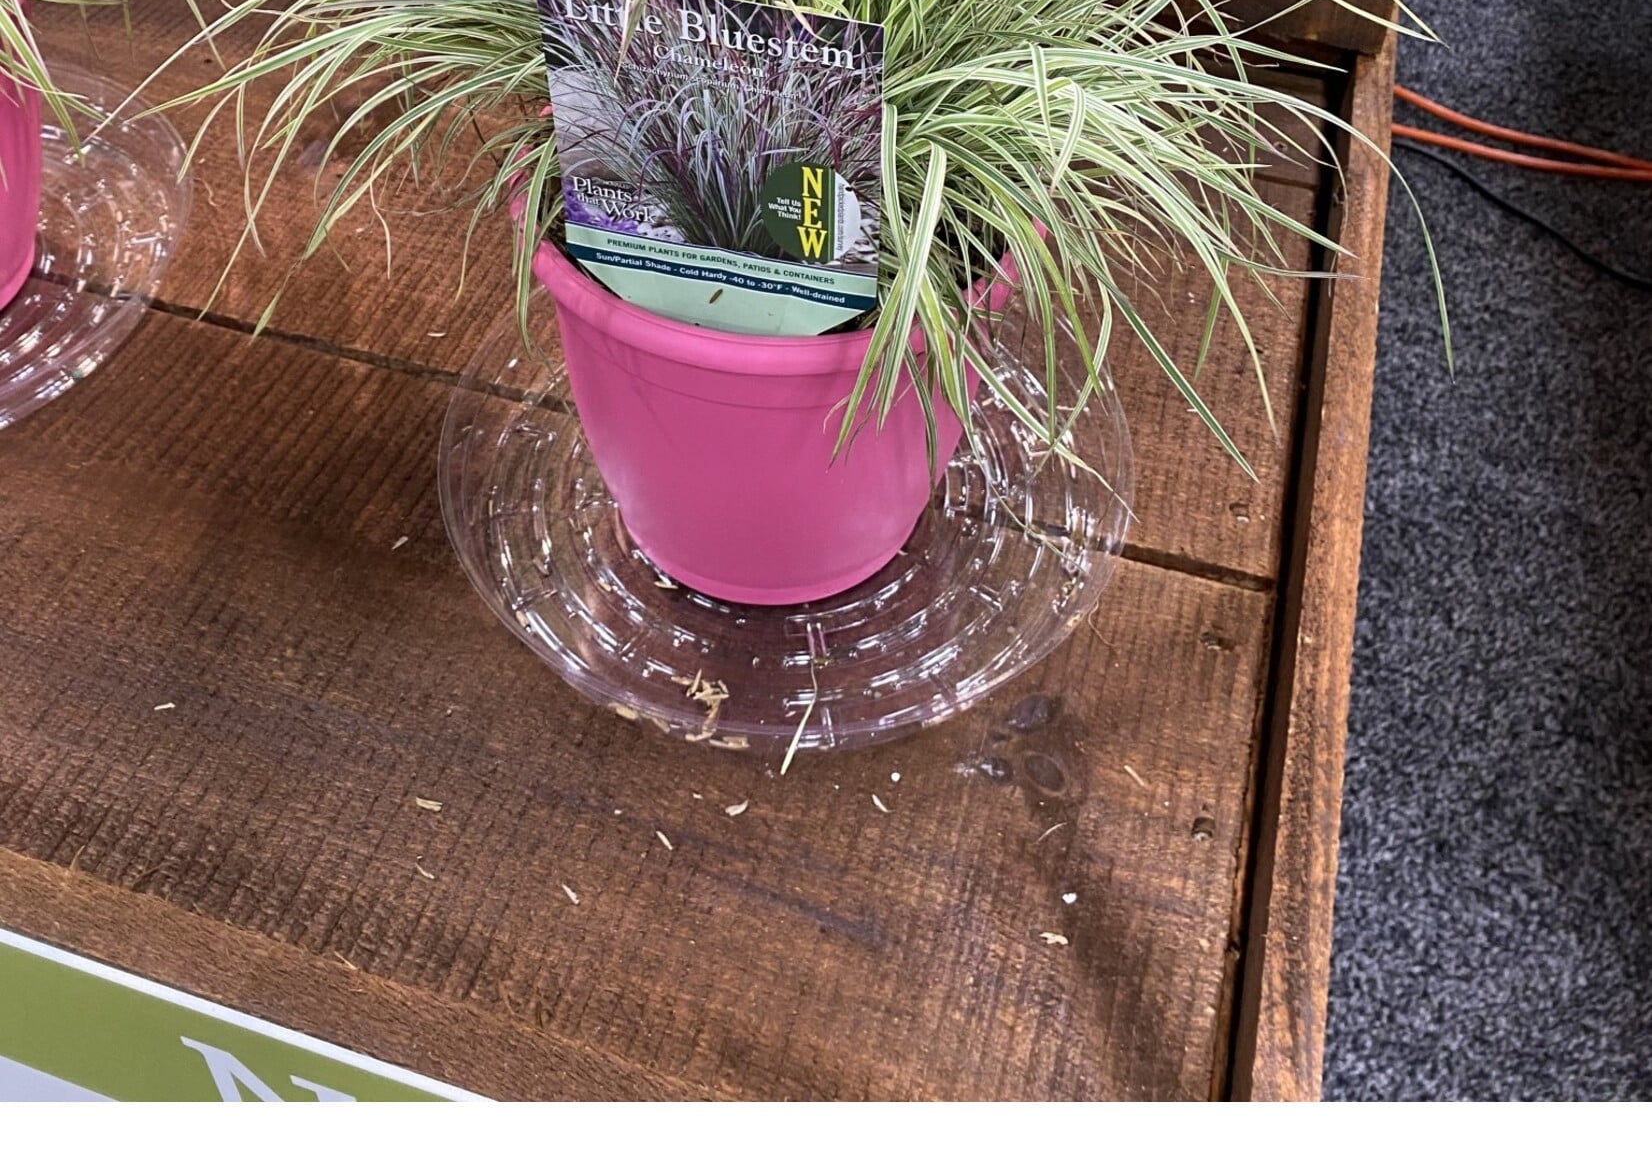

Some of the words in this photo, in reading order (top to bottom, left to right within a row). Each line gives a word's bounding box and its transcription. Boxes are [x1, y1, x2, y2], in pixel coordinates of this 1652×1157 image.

[676, 8, 855, 70] Bluestem
[570, 175, 632, 203] Plants
[577, 192, 600, 205] that
[600, 198, 657, 224] Work
[768, 202, 787, 211] What
[788, 205, 801, 214] You
[776, 196, 790, 205] Tell
[791, 199, 801, 207] Us
[796, 166, 827, 259] NEW
[596, 252, 643, 266] Sun/Partial
[645, 260, 671, 272] Shade
[679, 267, 699, 276] Cold
[701, 270, 727, 282] Hardy
[729, 275, 744, 285] -40
[746, 278, 755, 287] to
[791, 285, 846, 304] Well-drained
[607, 238, 646, 251] PREMIUM
[648, 246, 679, 257] PLANTS
[682, 251, 697, 261] FOR
[700, 254, 741, 268] GARDENS,
[742, 262, 771, 274] PATIOS
[774, 268, 781, 276] &
[783, 270, 835, 285] CONTAINERS
